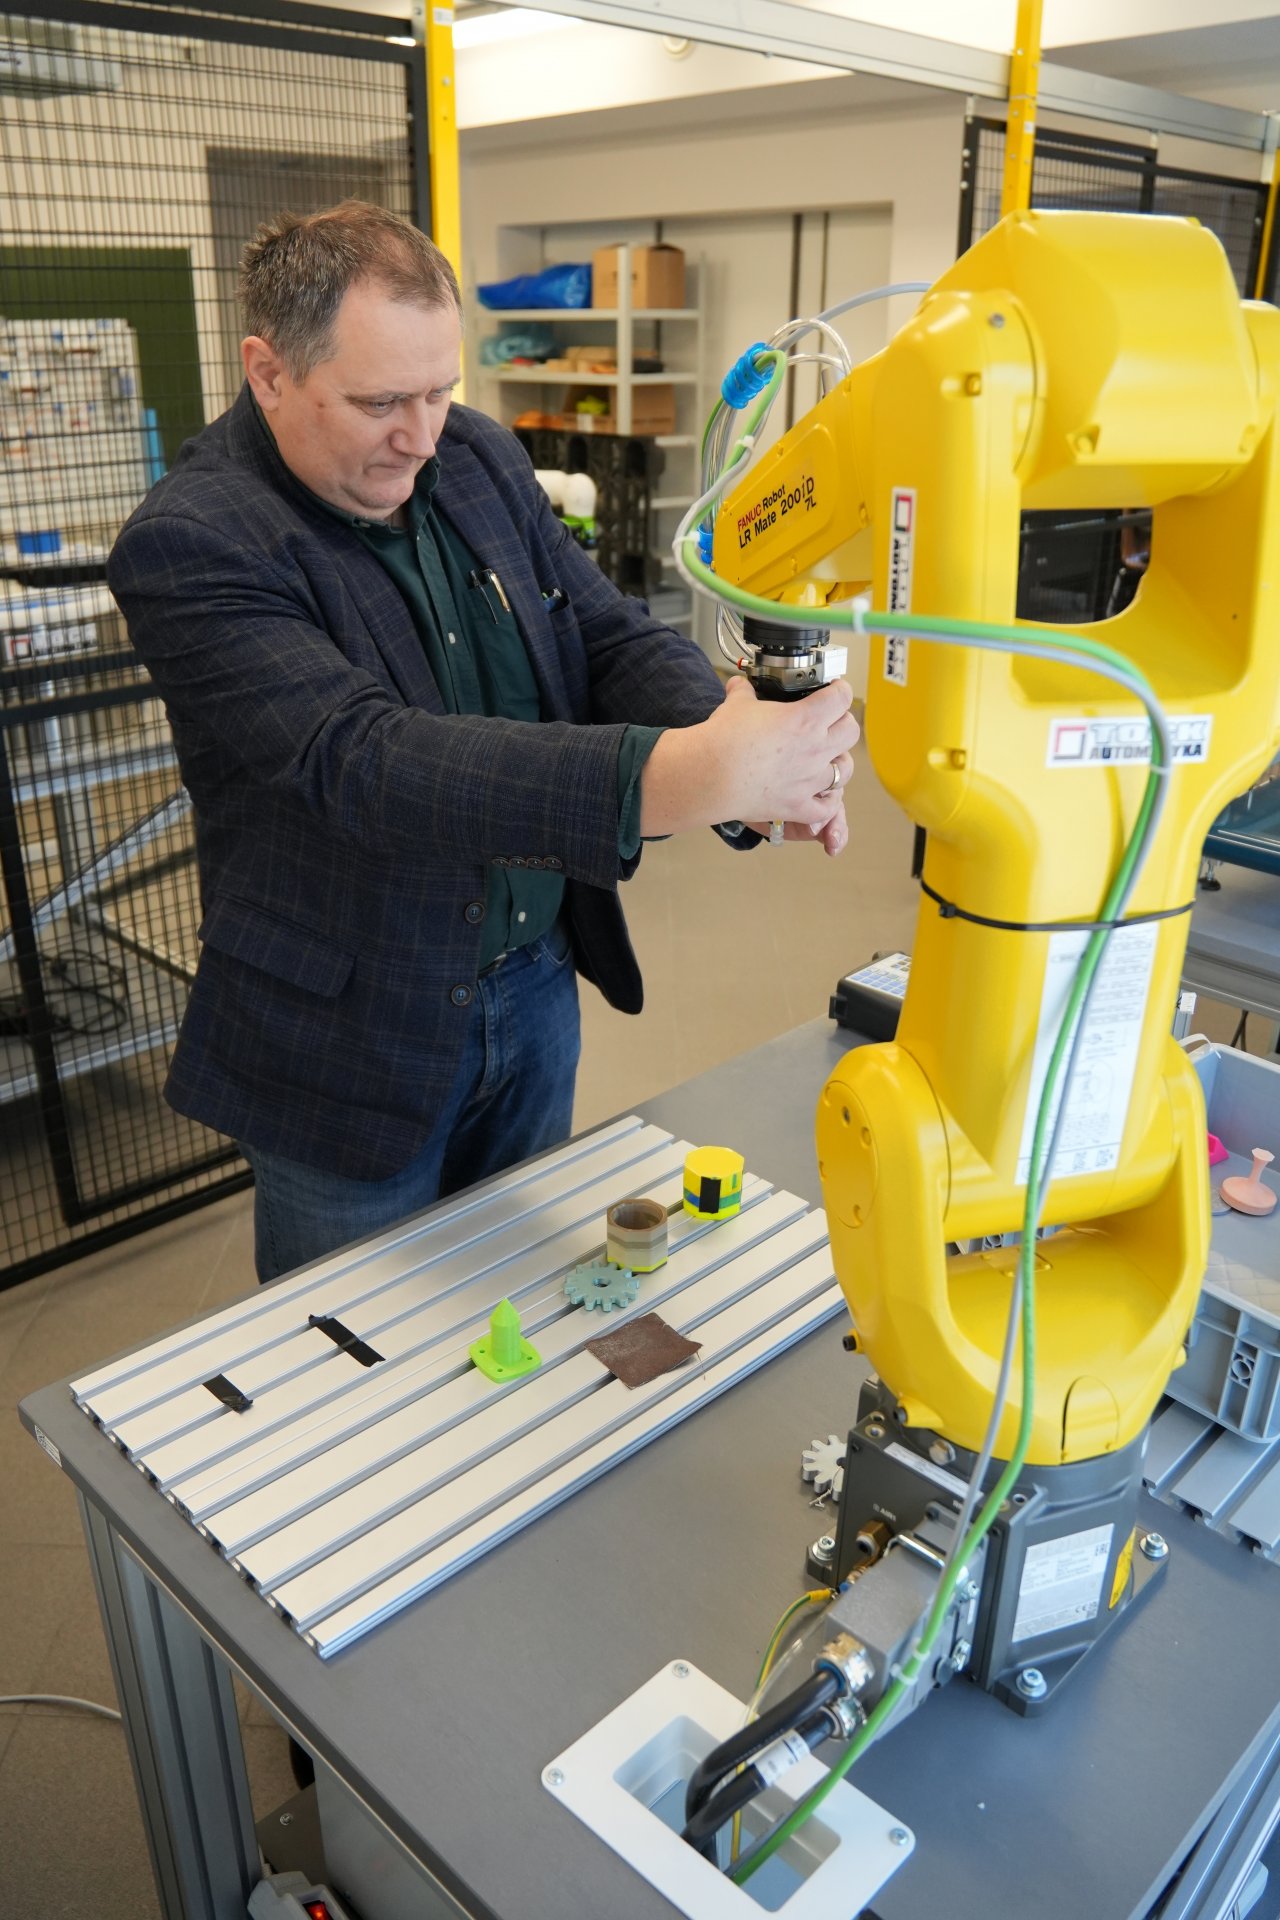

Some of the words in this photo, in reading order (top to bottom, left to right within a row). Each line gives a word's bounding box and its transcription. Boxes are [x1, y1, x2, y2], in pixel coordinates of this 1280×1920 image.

[737, 503, 762, 532] FANUC
[762, 484, 786, 511] Robot
[804, 495, 817, 512] 7L
[739, 529, 751, 549] LR
[754, 511, 777, 537] Mate
[1089, 744, 1202, 760] AUTOMYKA
